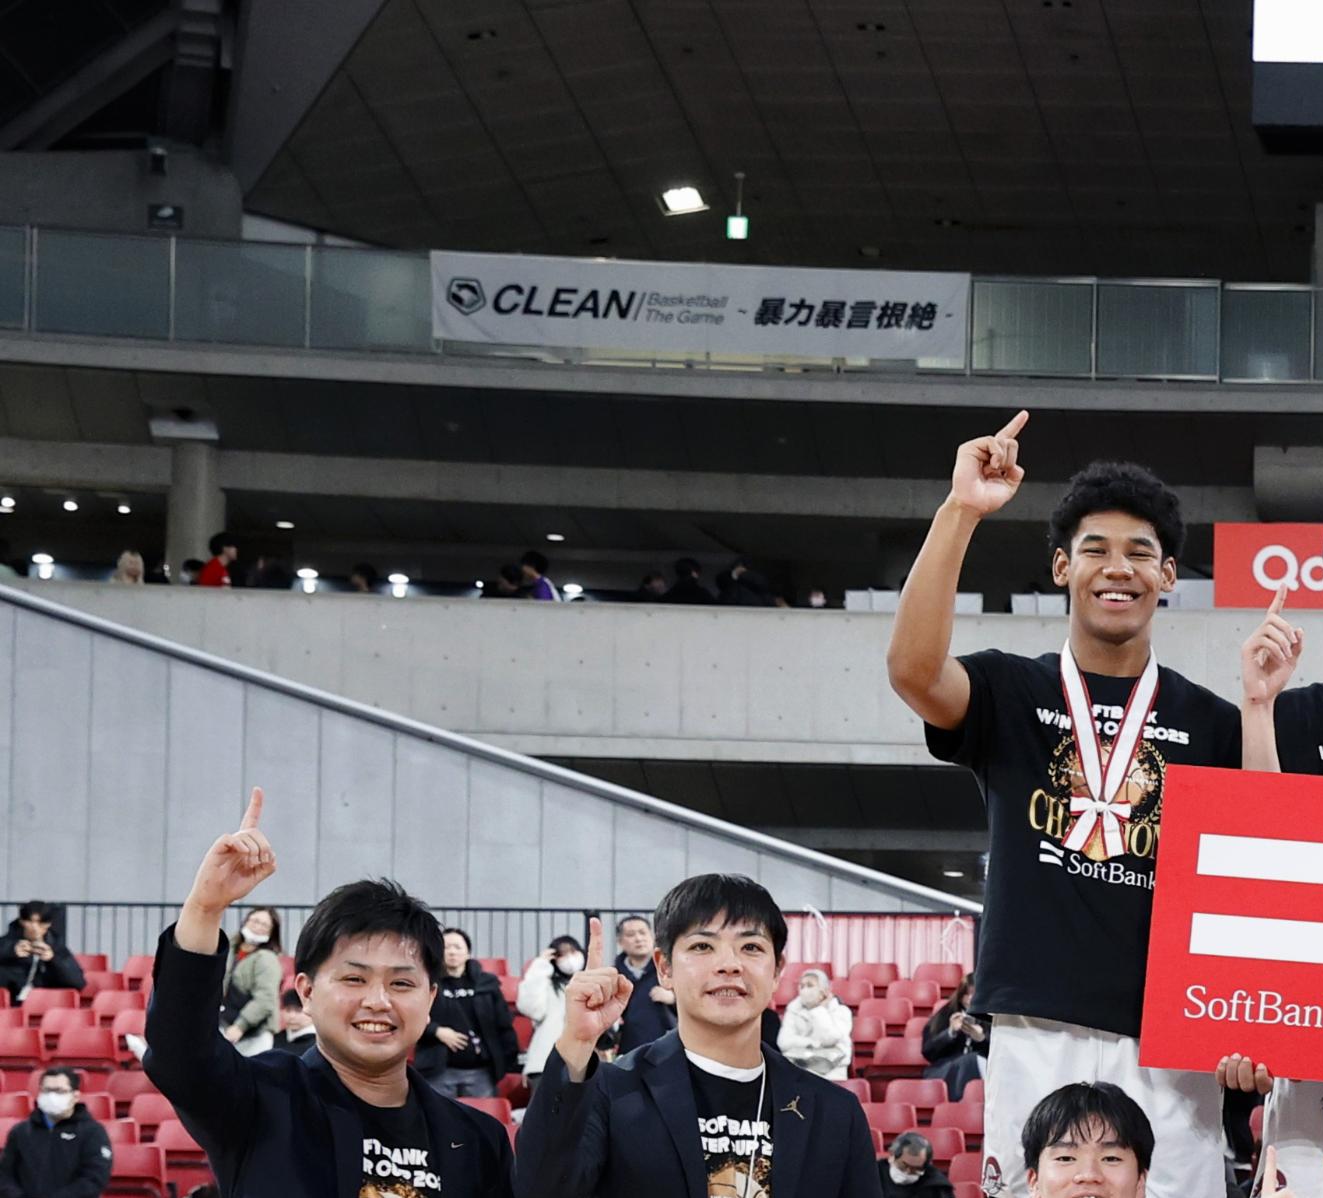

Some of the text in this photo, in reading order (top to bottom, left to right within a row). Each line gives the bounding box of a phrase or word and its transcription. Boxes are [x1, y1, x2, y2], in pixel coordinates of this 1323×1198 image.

[492, 283, 637, 321] CLEAN
[647, 291, 728, 309] Basketball
[646, 308, 725, 325] The Game
[1143, 725, 1190, 745] 2025
[362, 1138, 428, 1167] FTBANK
